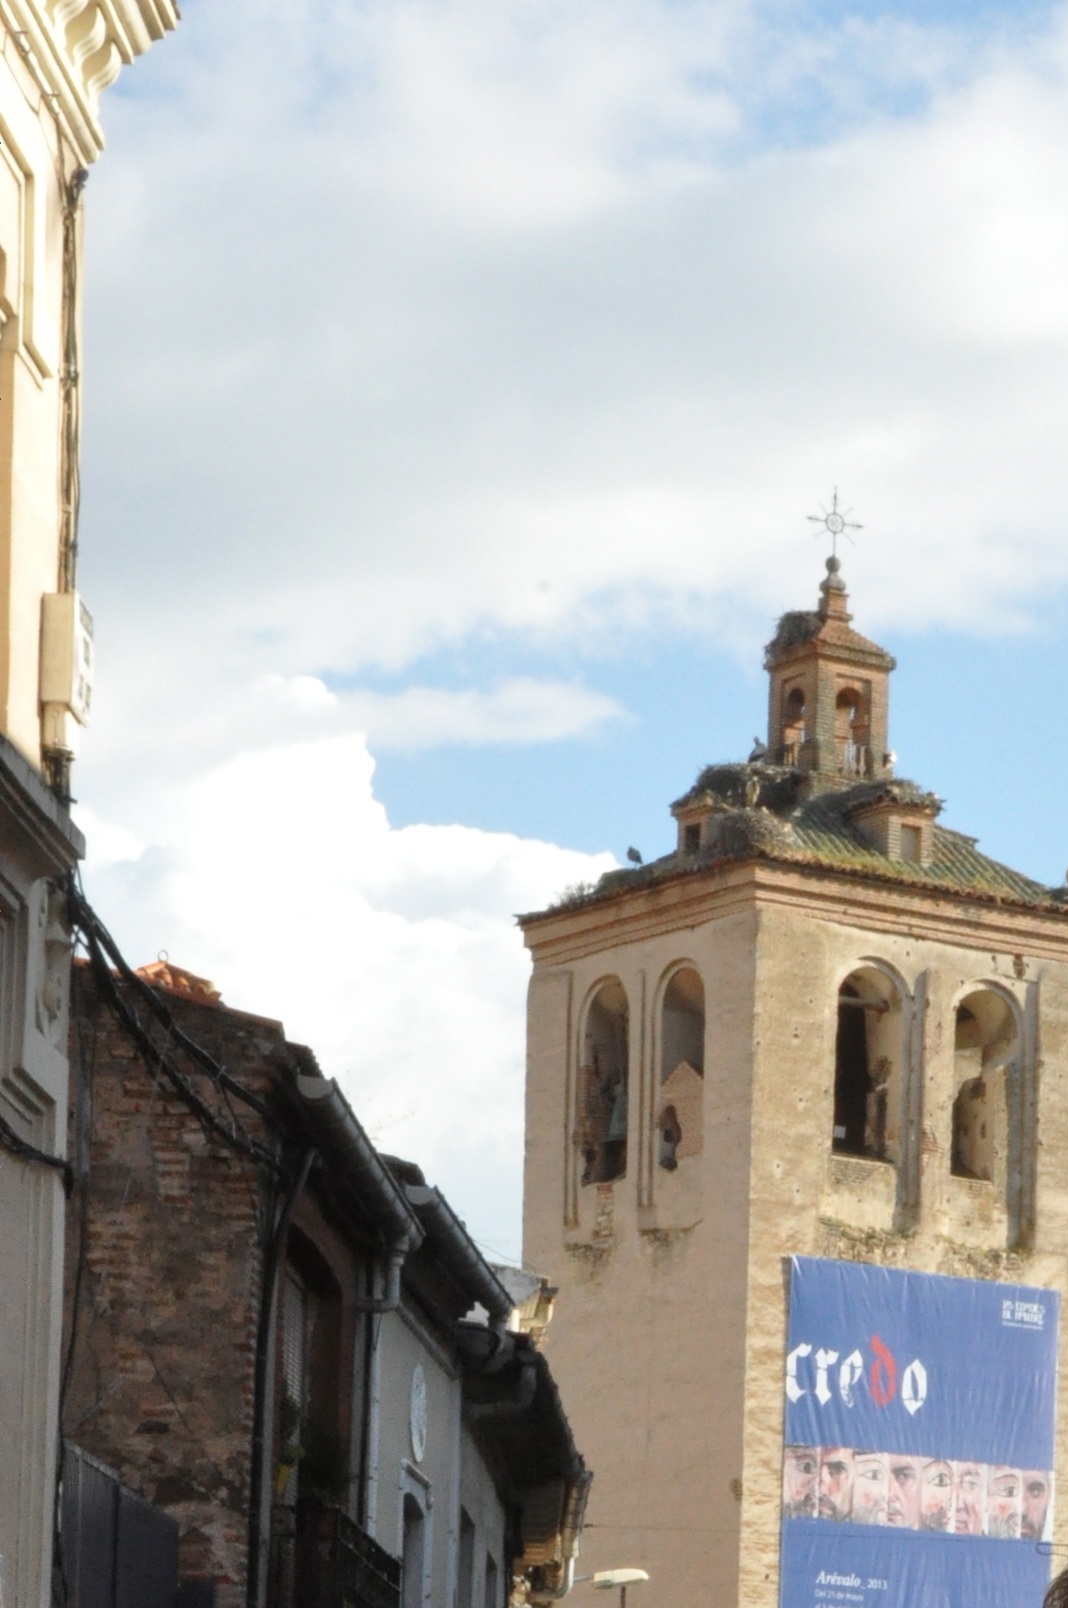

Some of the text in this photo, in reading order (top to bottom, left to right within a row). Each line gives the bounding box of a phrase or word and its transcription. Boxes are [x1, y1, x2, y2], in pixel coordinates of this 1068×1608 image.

[786, 1334, 928, 1416] credo
[815, 1570, 861, 1588] Arévalo
[867, 1578, 888, 1591] 2013
